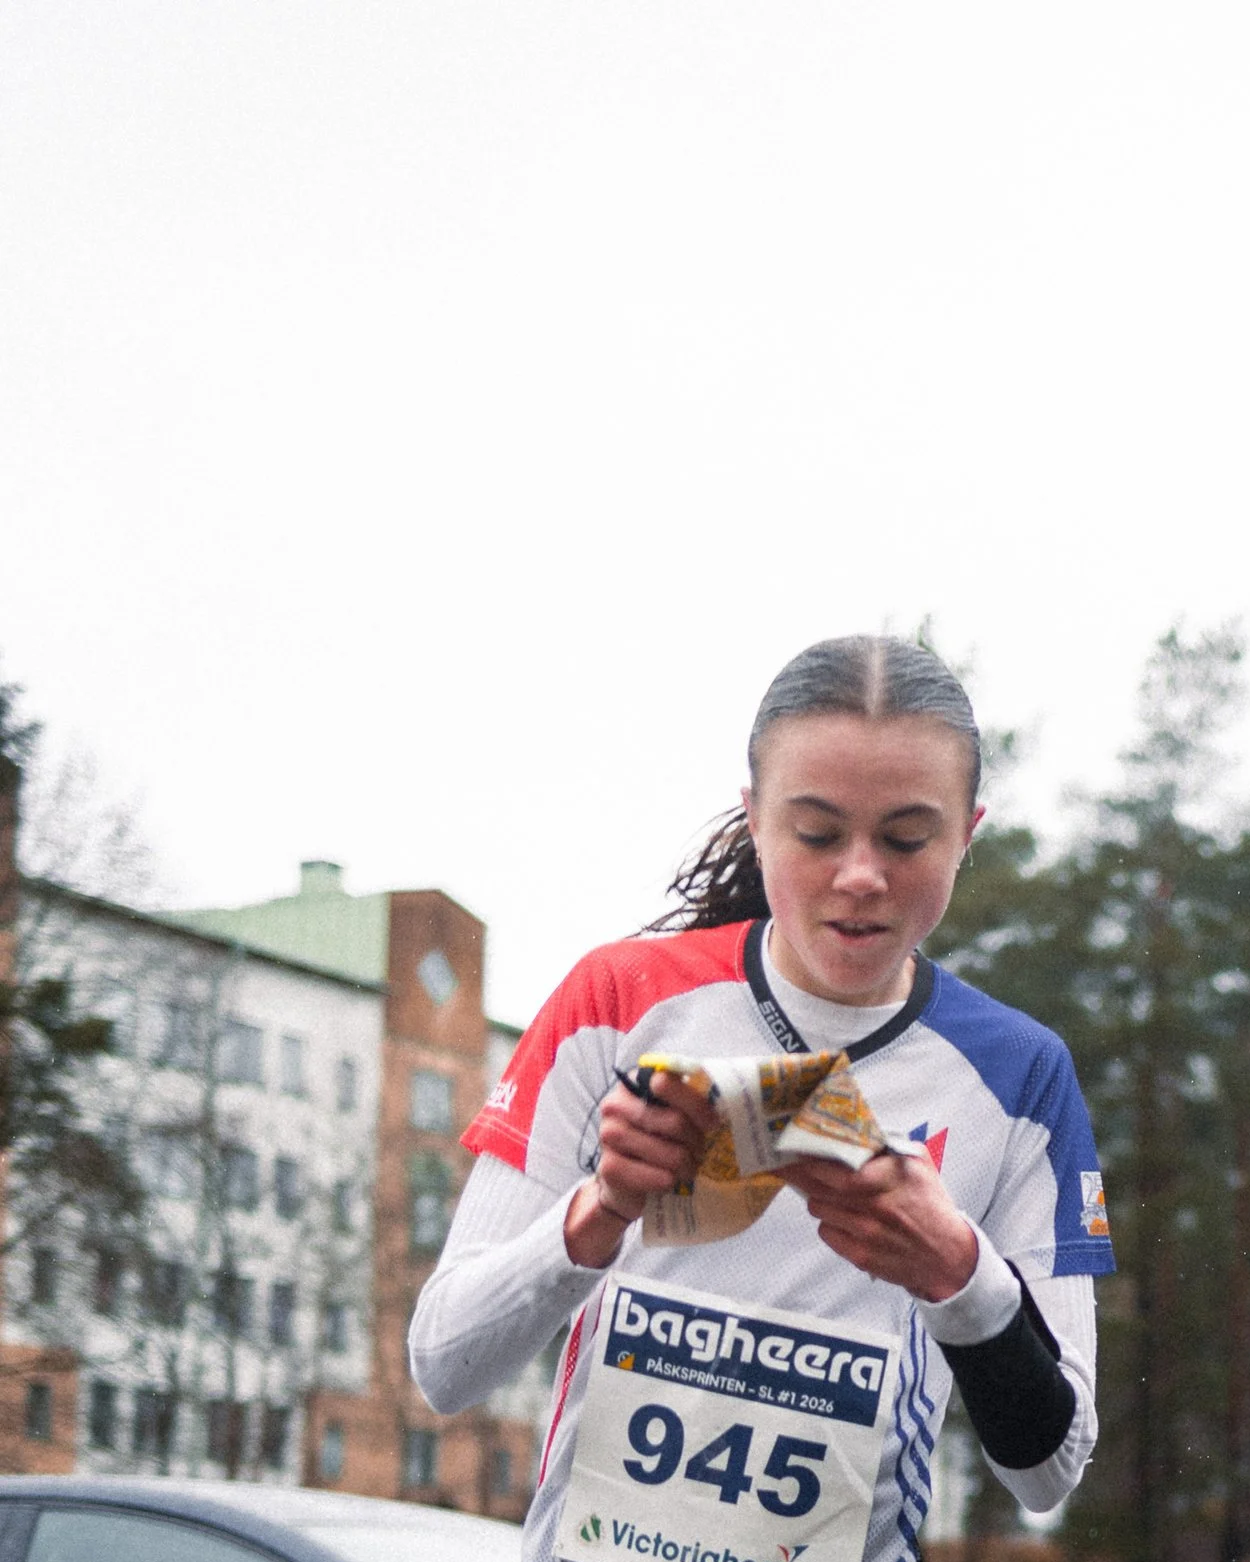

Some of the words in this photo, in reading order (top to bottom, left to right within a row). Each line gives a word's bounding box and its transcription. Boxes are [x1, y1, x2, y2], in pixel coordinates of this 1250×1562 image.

[614, 1291, 883, 1392] bagheera
[646, 1357, 746, 1393] PÅSKSPRINTEN
[758, 1385, 774, 1401] SL
[777, 1389, 796, 1405] #1
[799, 1394, 835, 1413] 2026
[623, 1403, 828, 1518] 945
